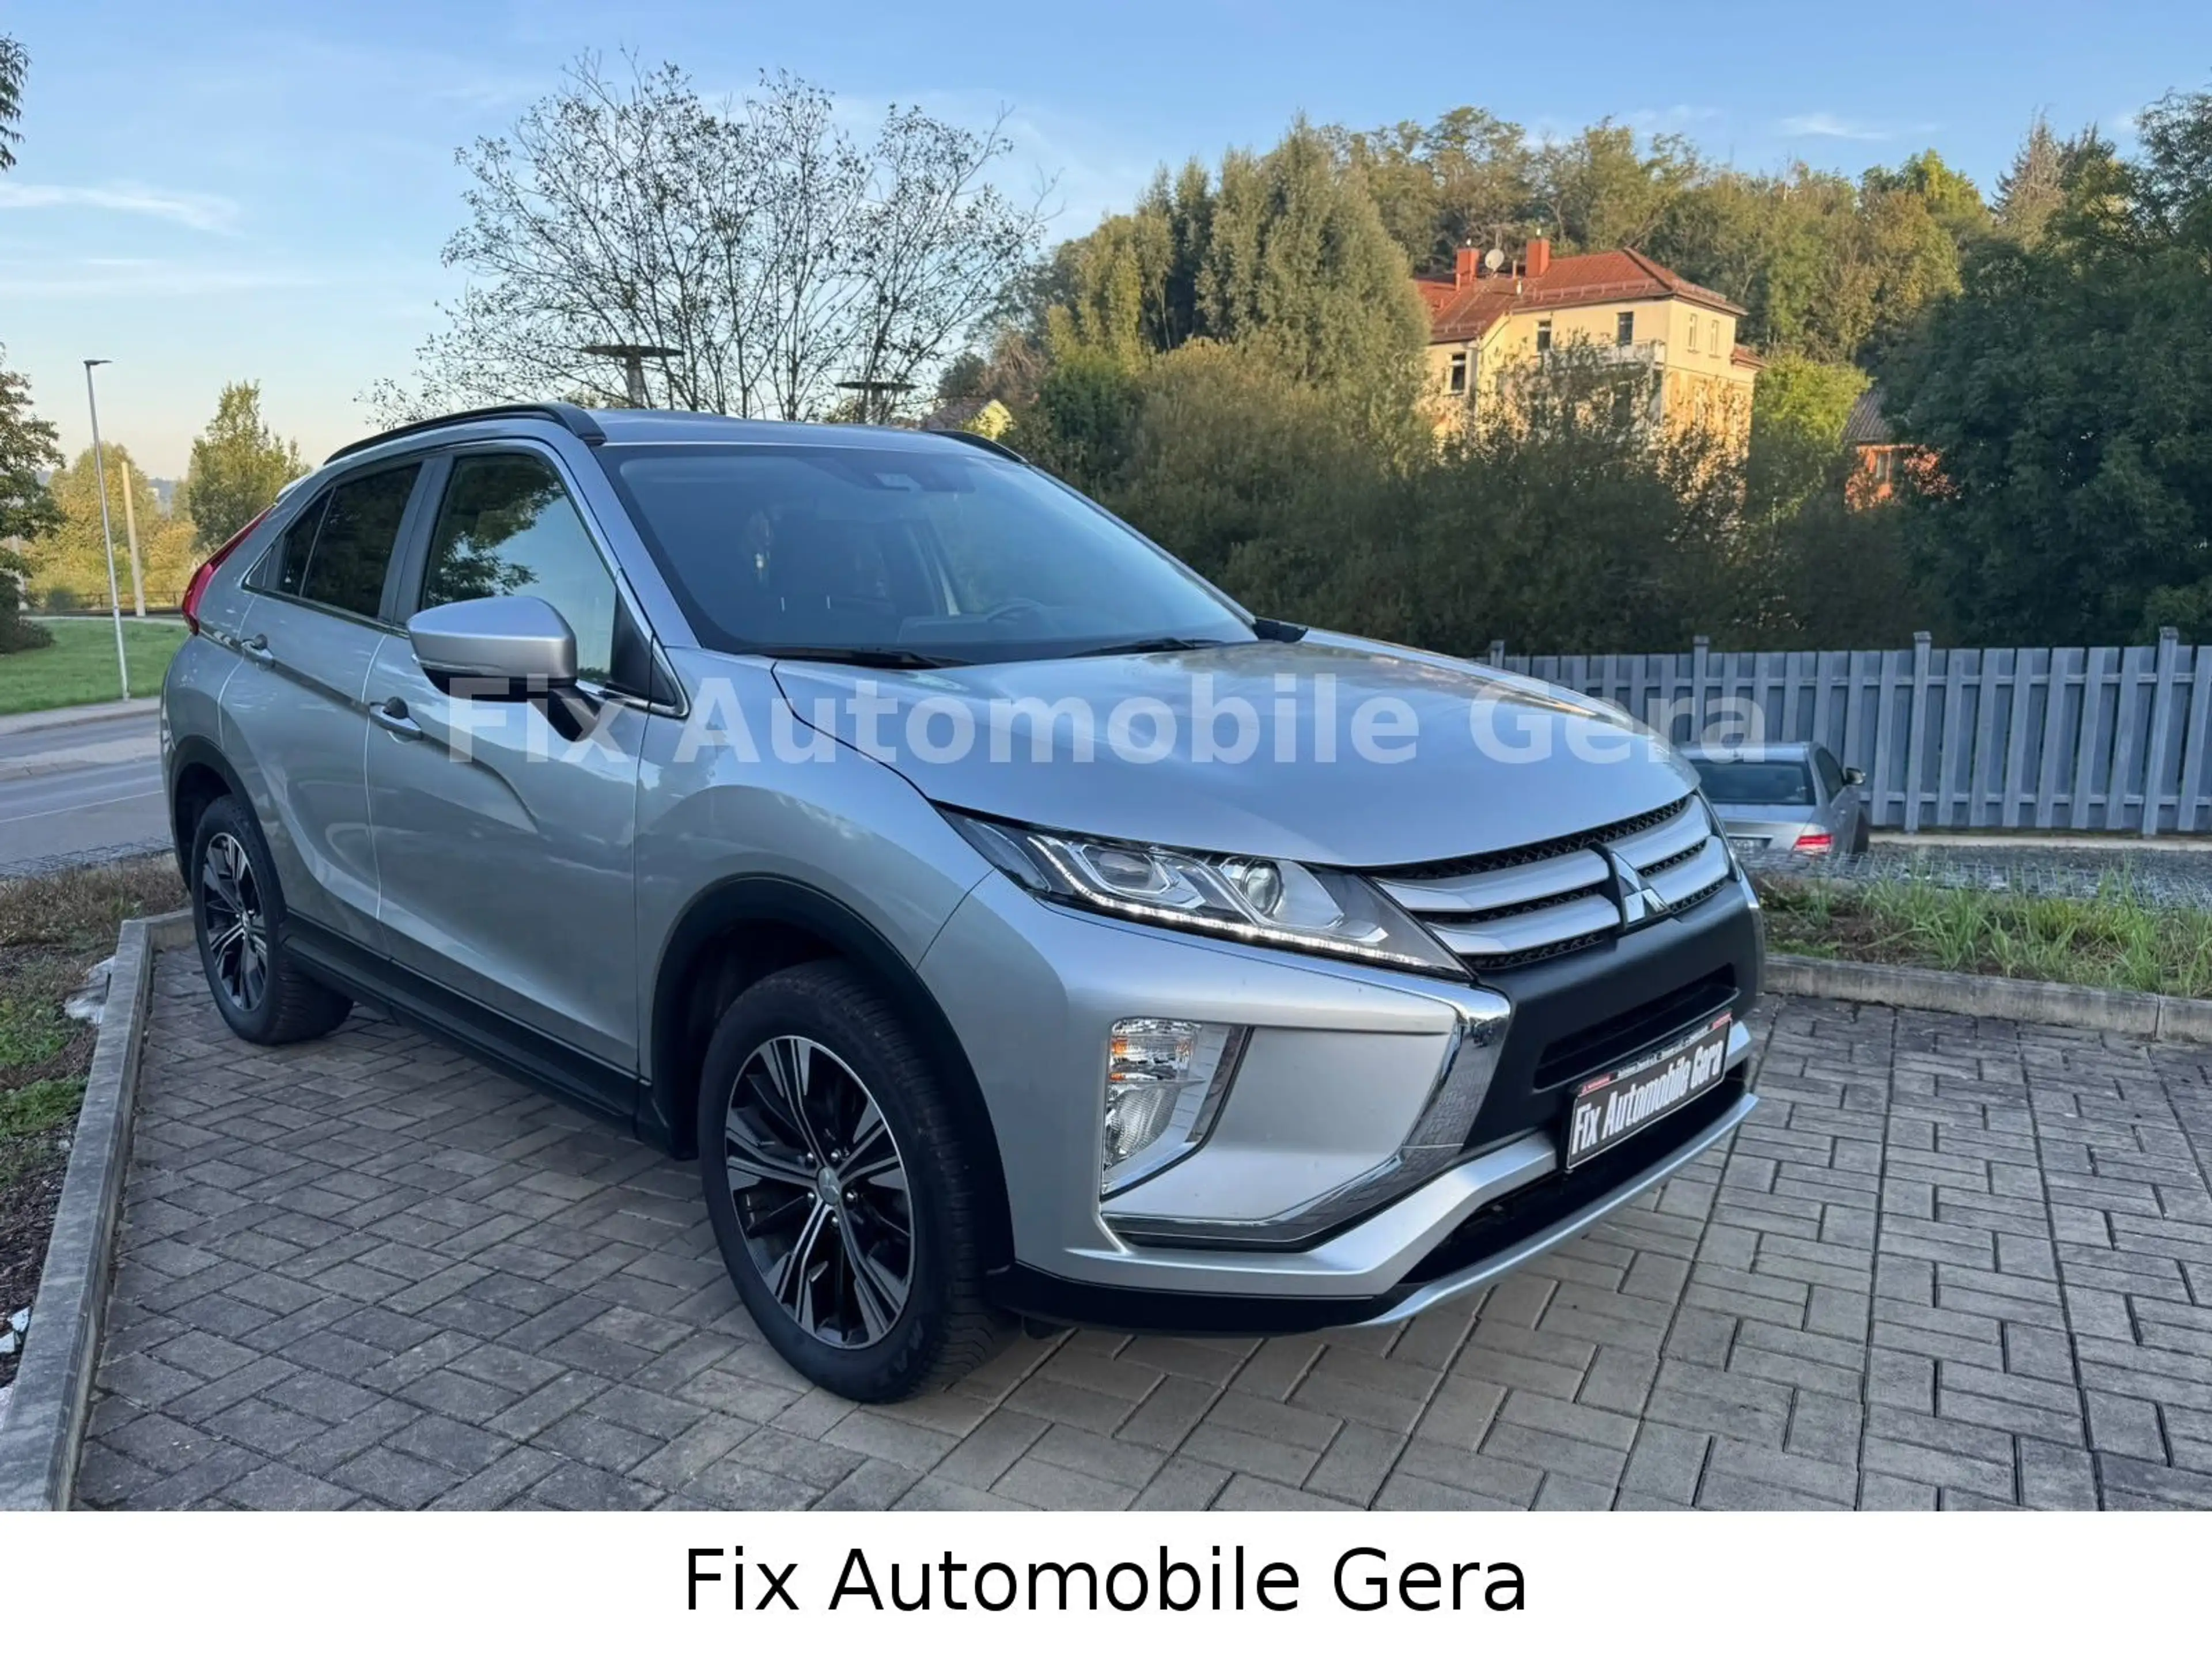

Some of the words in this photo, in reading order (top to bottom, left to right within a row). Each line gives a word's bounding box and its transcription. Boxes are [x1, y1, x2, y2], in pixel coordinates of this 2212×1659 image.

[1571, 1101, 1601, 1154] Fix
[1601, 1055, 1692, 1140] Automobile
[1690, 1040, 1724, 1090] Gera
